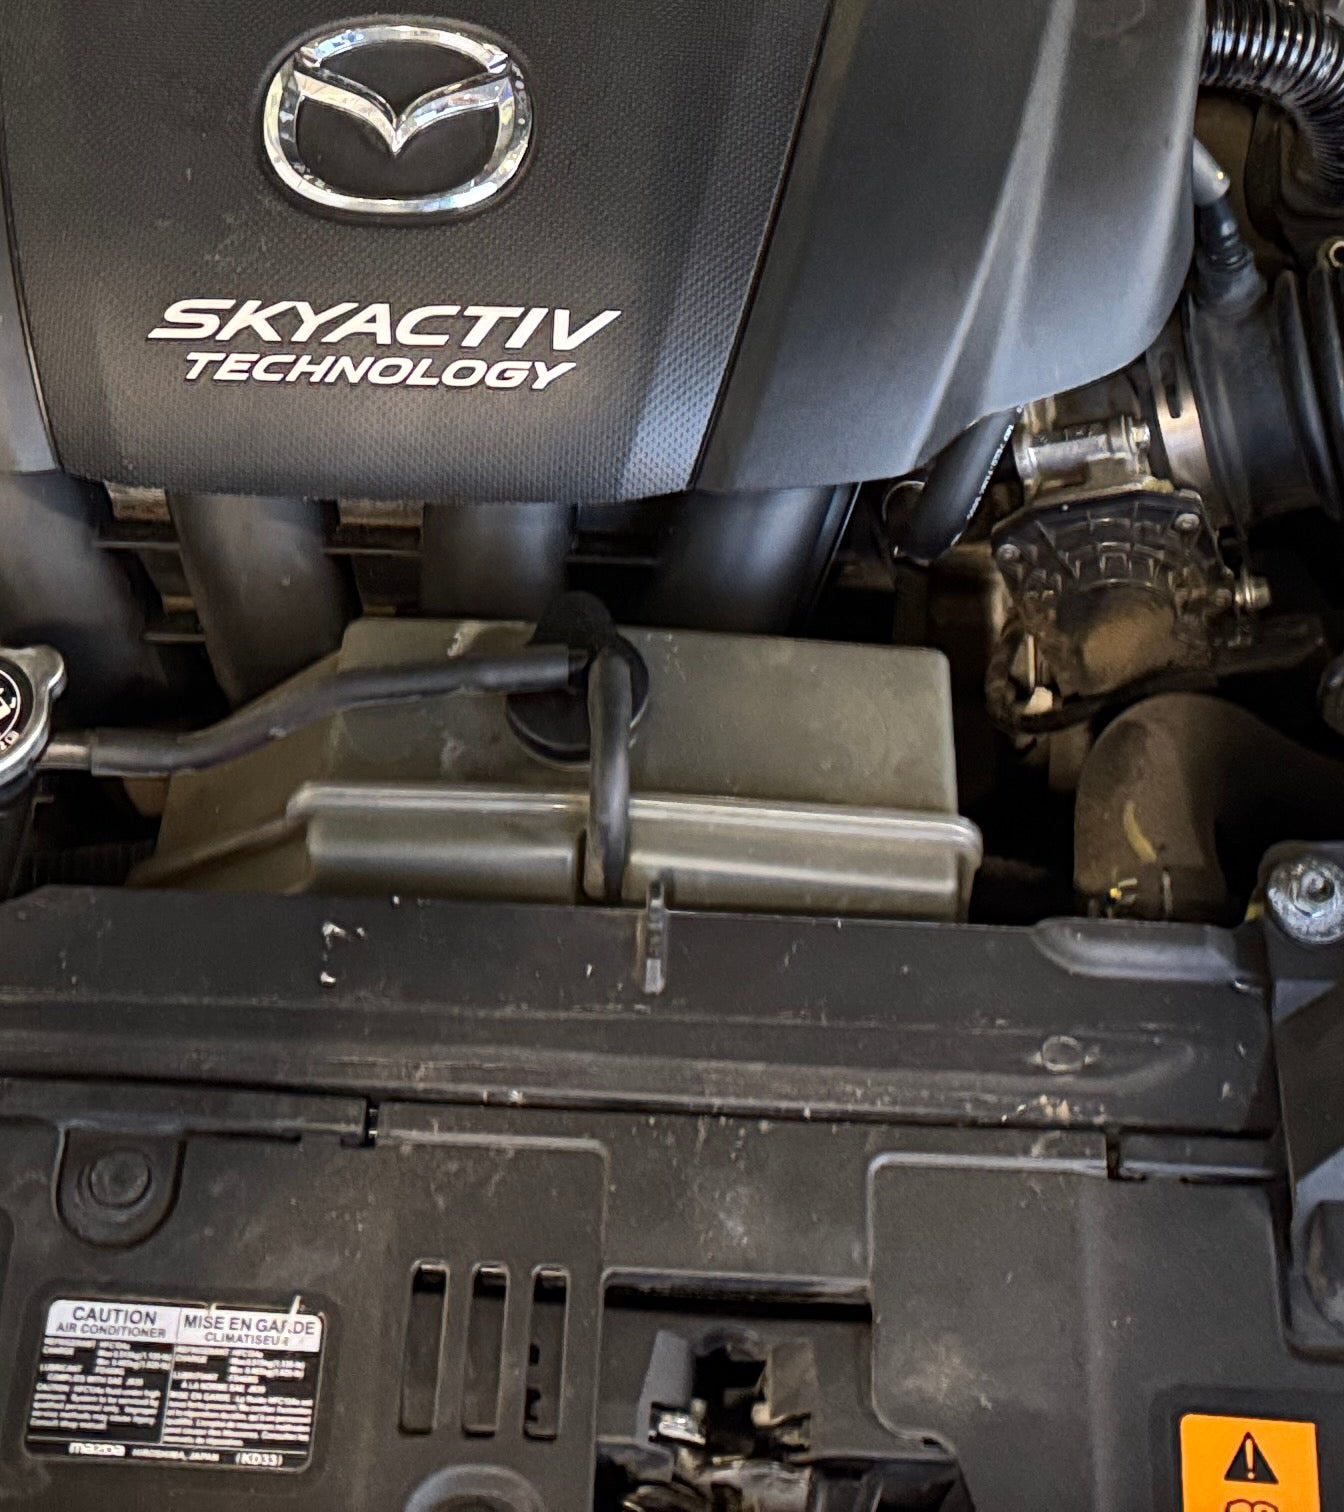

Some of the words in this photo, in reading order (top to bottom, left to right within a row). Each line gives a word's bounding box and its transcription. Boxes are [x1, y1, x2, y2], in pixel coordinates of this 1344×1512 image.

[147, 298, 622, 351] SKYACTIV
[184, 352, 577, 391] TECHNOLOGY
[73, 1306, 158, 1326] CAUTION
[184, 1314, 223, 1330] MISE
[228, 1318, 254, 1331] EN
[56, 1321, 79, 1334] AIR
[80, 1324, 167, 1339] CONDITIONER
[236, 1452, 284, 1467] (KD33)
